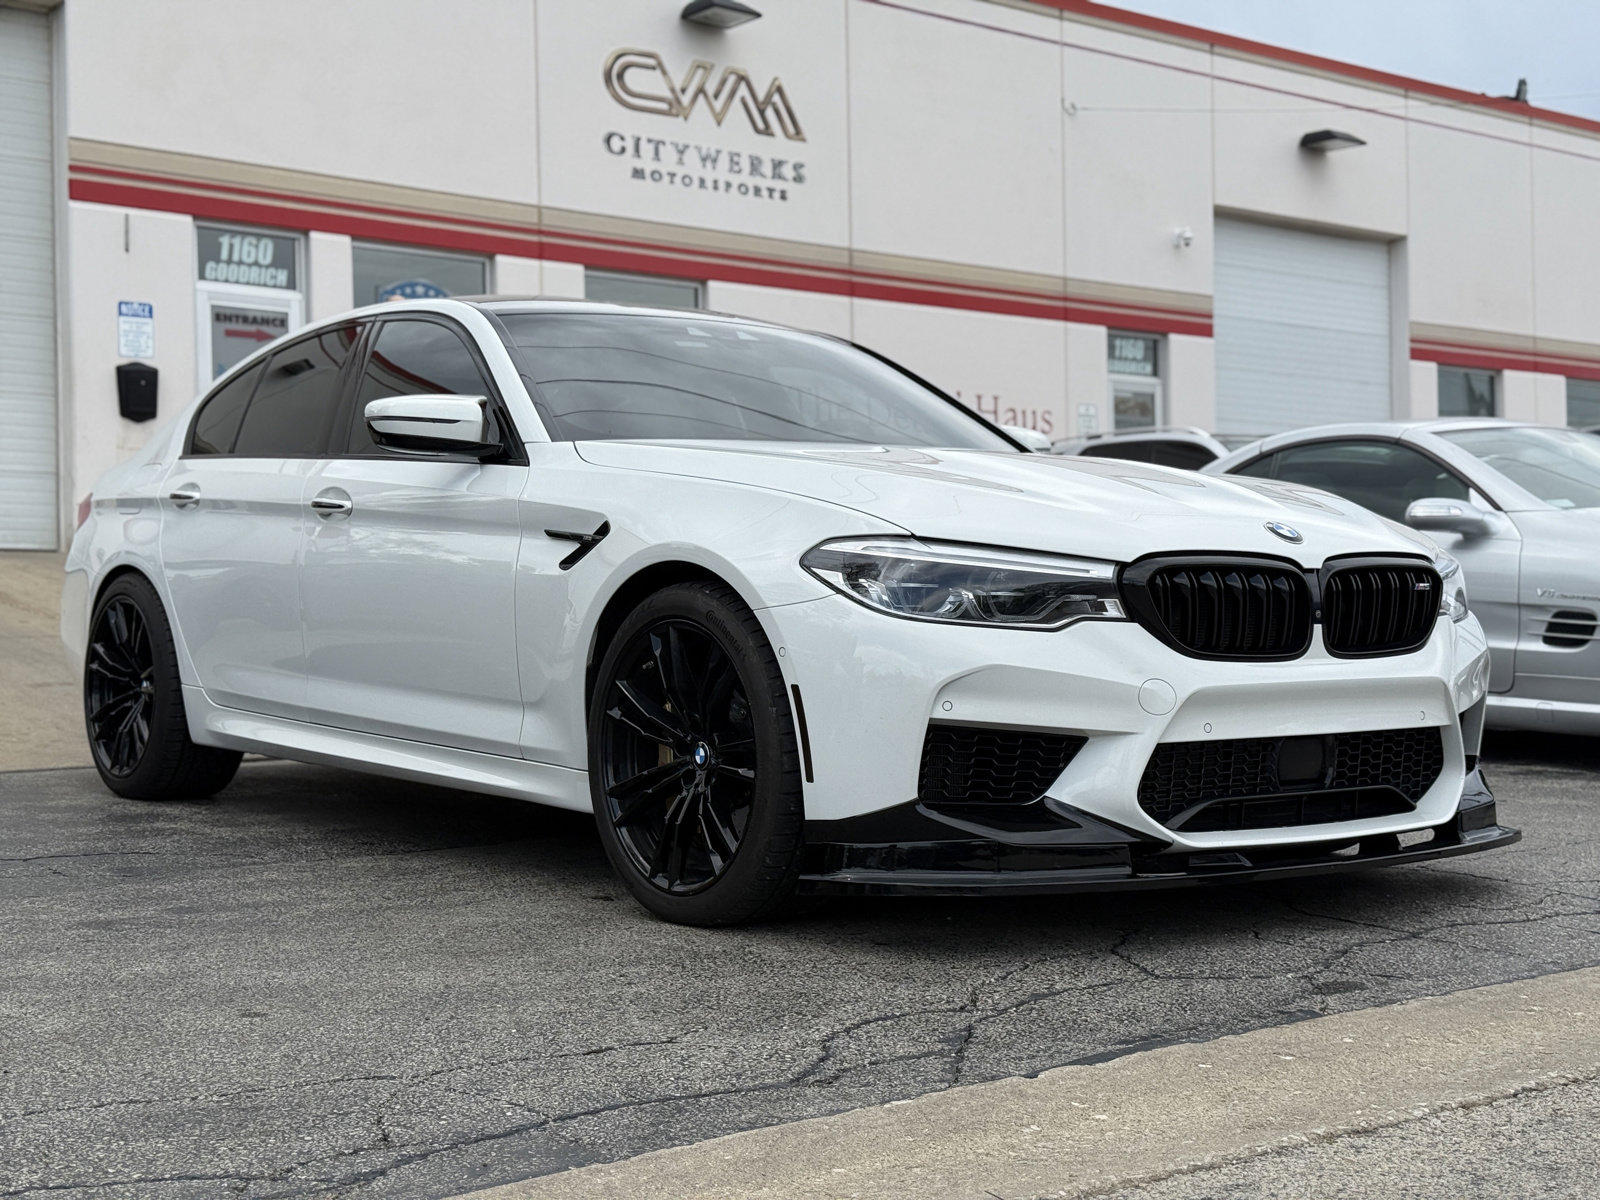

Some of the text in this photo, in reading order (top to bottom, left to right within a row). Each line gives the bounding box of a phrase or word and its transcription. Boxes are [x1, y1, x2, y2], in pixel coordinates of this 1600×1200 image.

[603, 131, 807, 184] CITYWERKS
[631, 167, 788, 201] MOTORSPORTS
[218, 233, 274, 266] 1160
[204, 261, 288, 287] GOODRICH
[214, 313, 286, 328] ENTRANCE
[975, 393, 1054, 434] Haus
